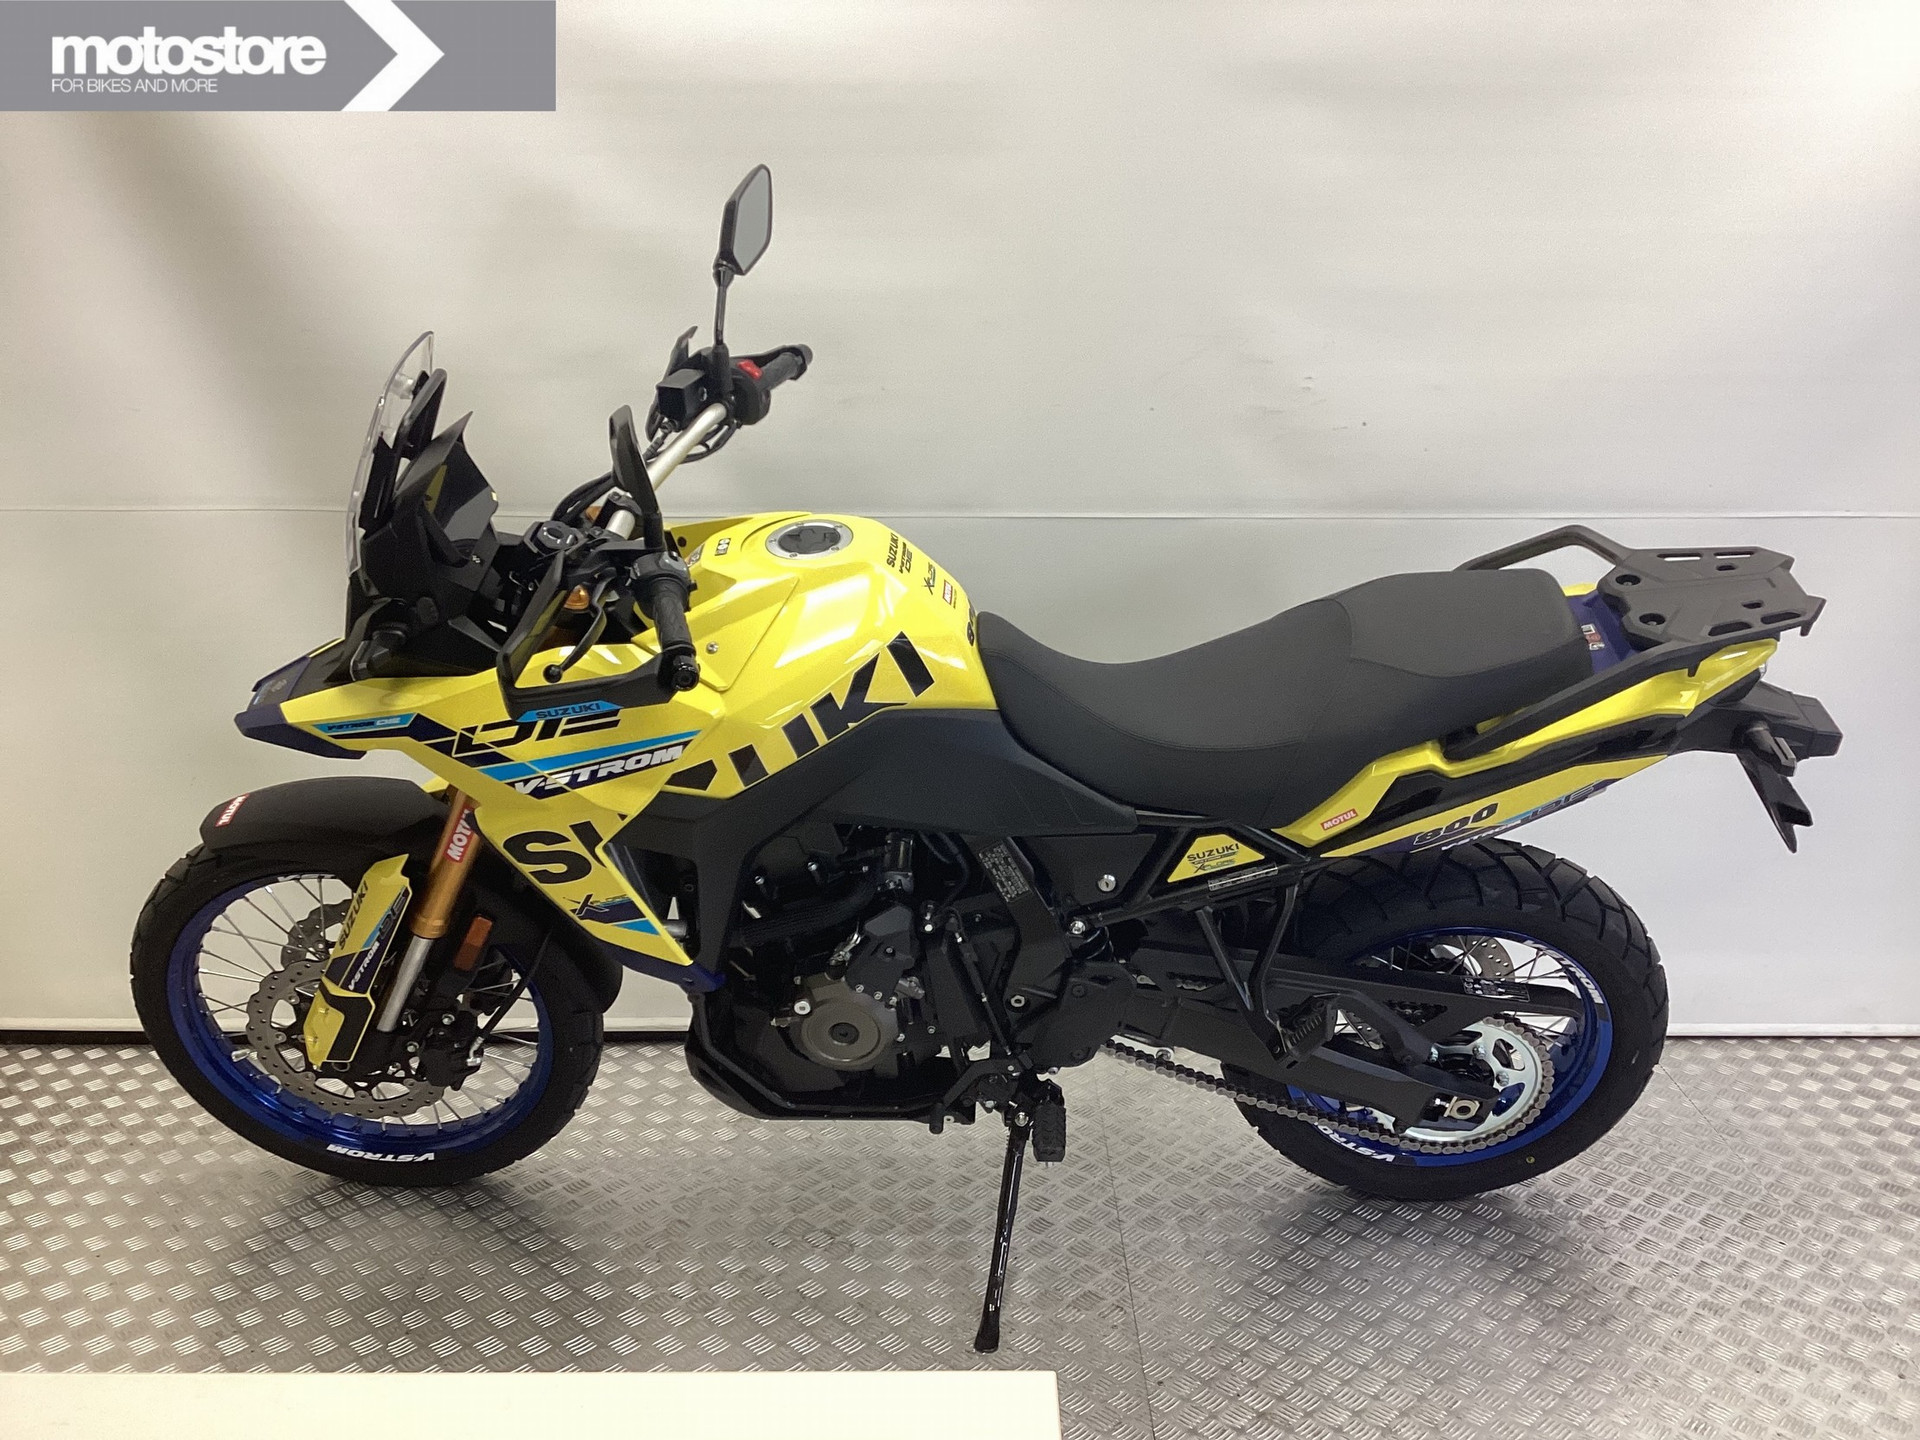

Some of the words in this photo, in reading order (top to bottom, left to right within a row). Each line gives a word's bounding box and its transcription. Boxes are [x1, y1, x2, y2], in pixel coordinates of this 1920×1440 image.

[886, 533, 899, 568] SUZUKI
[536, 702, 601, 719] SUZUKI
[514, 745, 683, 795] V-STROM
[447, 808, 472, 861] MOT
[1323, 810, 1357, 829] MOTUL
[1413, 802, 1499, 845] 800
[1187, 843, 1240, 861] SUZUKI
[339, 880, 369, 949] SUZUKI
[349, 941, 380, 991] V-STROM
[1522, 939, 1604, 1004] V-STROM
[326, 1144, 435, 1162] V-STROM
[1314, 1122, 1395, 1162] V-STRO
